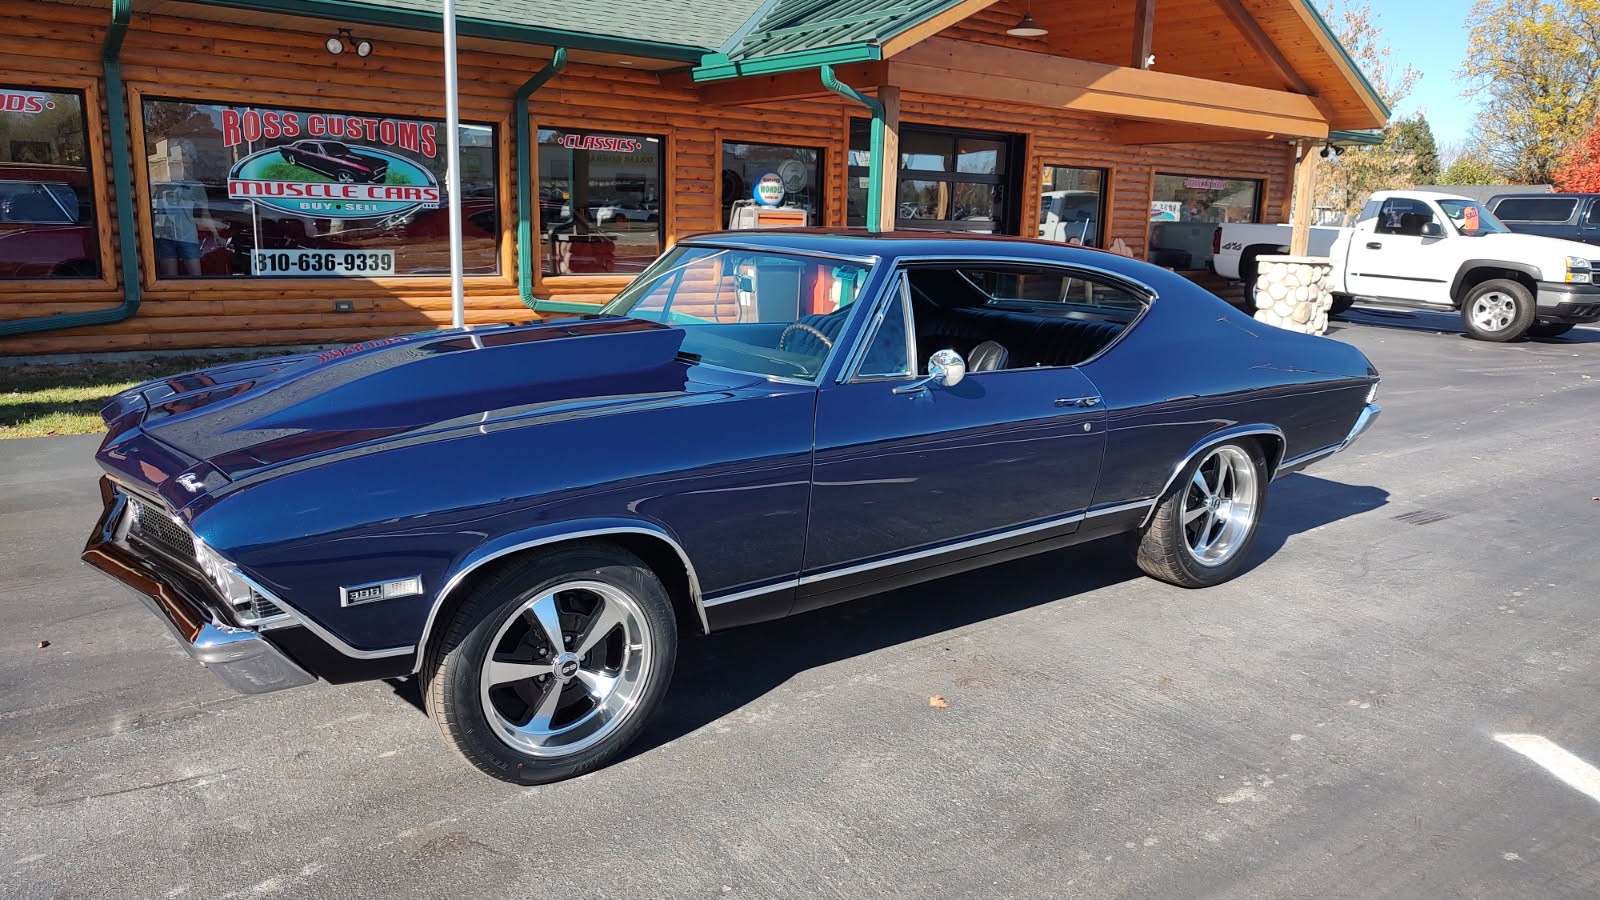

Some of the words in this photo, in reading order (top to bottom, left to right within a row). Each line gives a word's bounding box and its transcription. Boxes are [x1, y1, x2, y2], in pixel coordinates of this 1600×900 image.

[0, 93, 44, 113] DS
[221, 109, 299, 147] ROSS
[307, 115, 437, 158] CUSTOMS
[229, 181, 361, 198] MUSCLE
[367, 186, 439, 201] CARS
[300, 202, 332, 210] BUY
[345, 203, 379, 211] SELL
[254, 253, 392, 272] 810-636-9339
